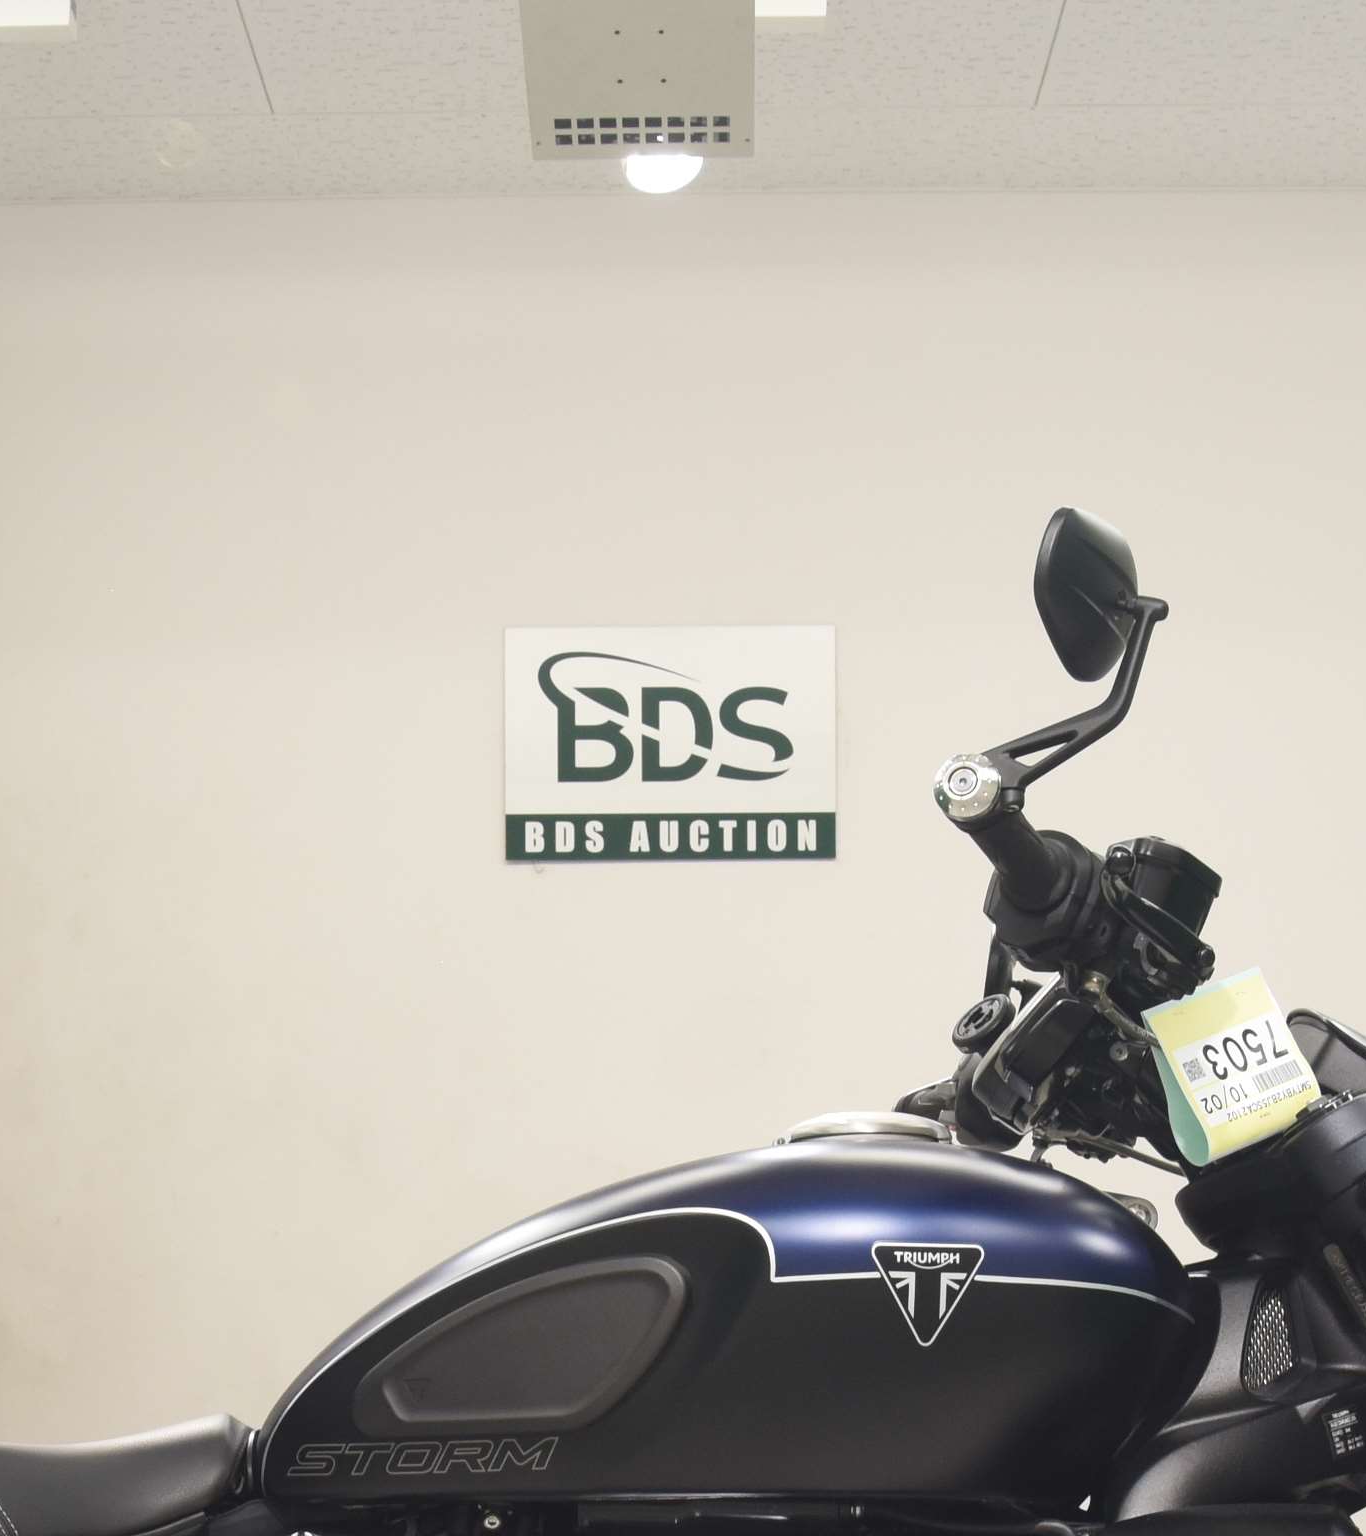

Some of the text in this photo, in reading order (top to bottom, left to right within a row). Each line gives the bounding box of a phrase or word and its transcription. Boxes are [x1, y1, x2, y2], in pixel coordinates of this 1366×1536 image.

[538, 652, 794, 782] BDS
[524, 819, 817, 853] BDS AUCTION
[1203, 1020, 1288, 1080] 7503
[1200, 1083, 1248, 1115] 10/02
[894, 1251, 960, 1269] TRIUMPH
[287, 1437, 559, 1476] STORM
